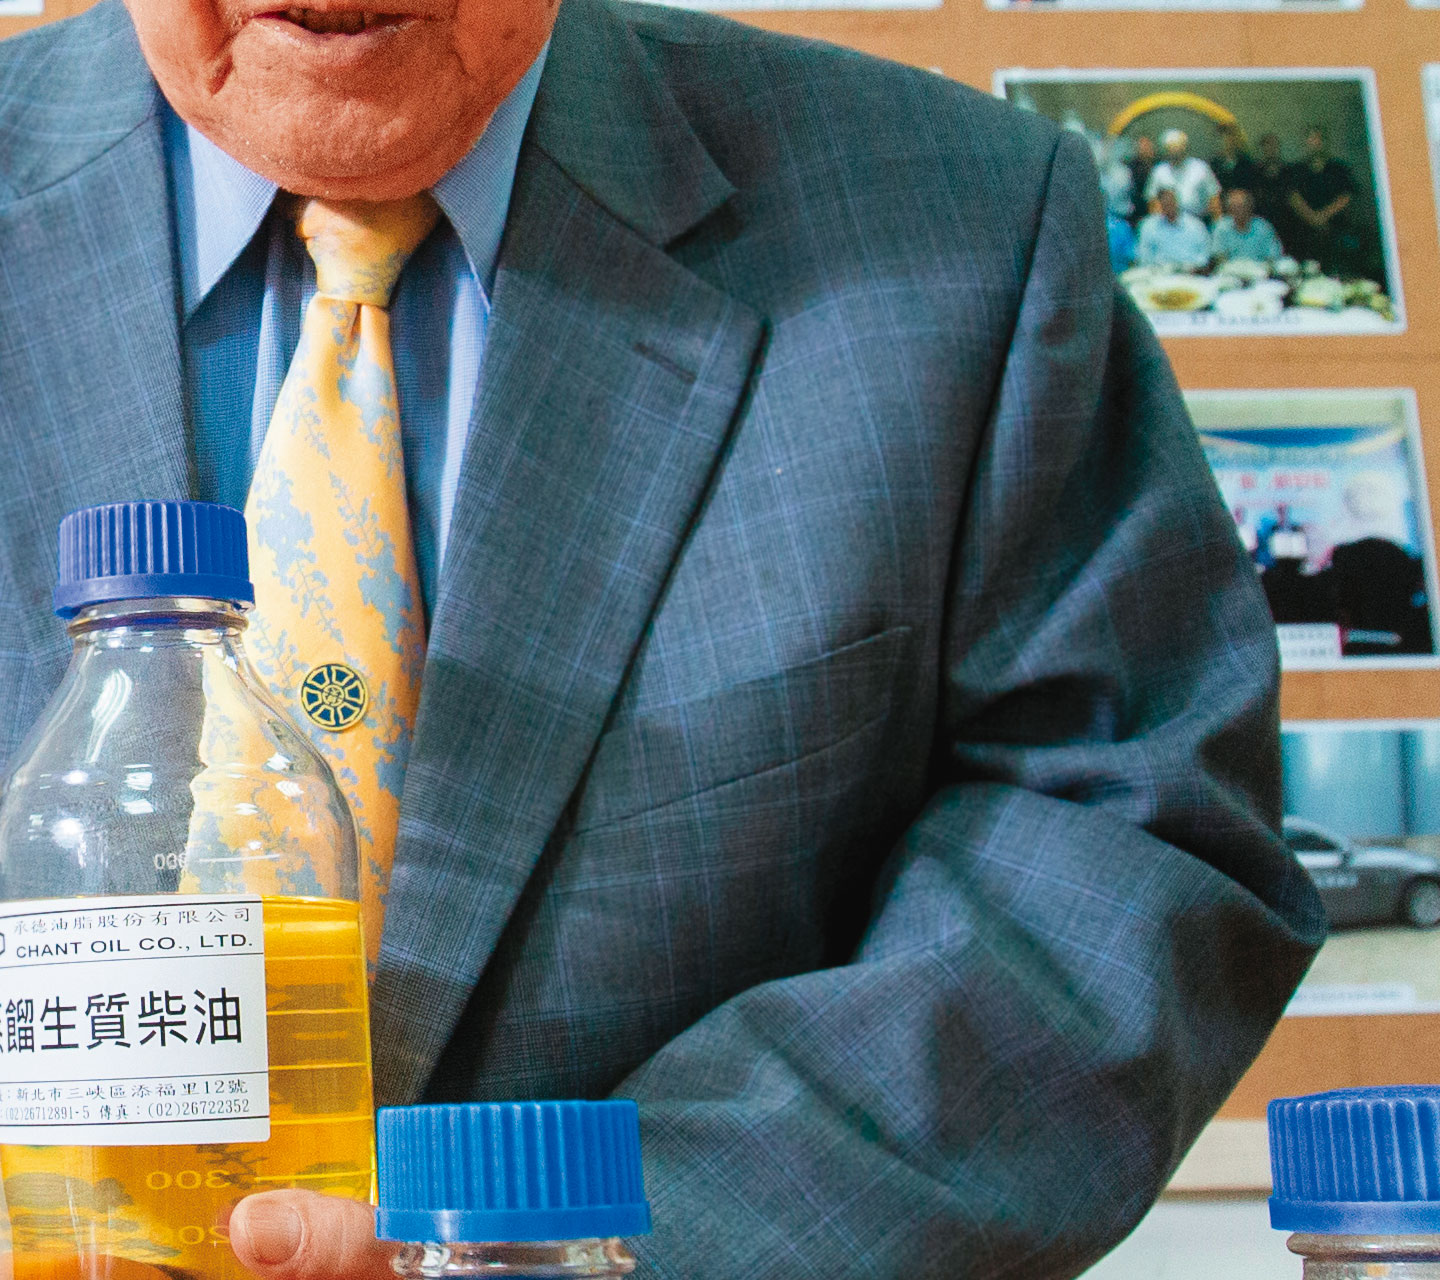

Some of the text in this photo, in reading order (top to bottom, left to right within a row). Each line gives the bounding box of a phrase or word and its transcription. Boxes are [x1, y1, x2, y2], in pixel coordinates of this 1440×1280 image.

[16, 933, 253, 959] CHANT OIL CO., LTD.
